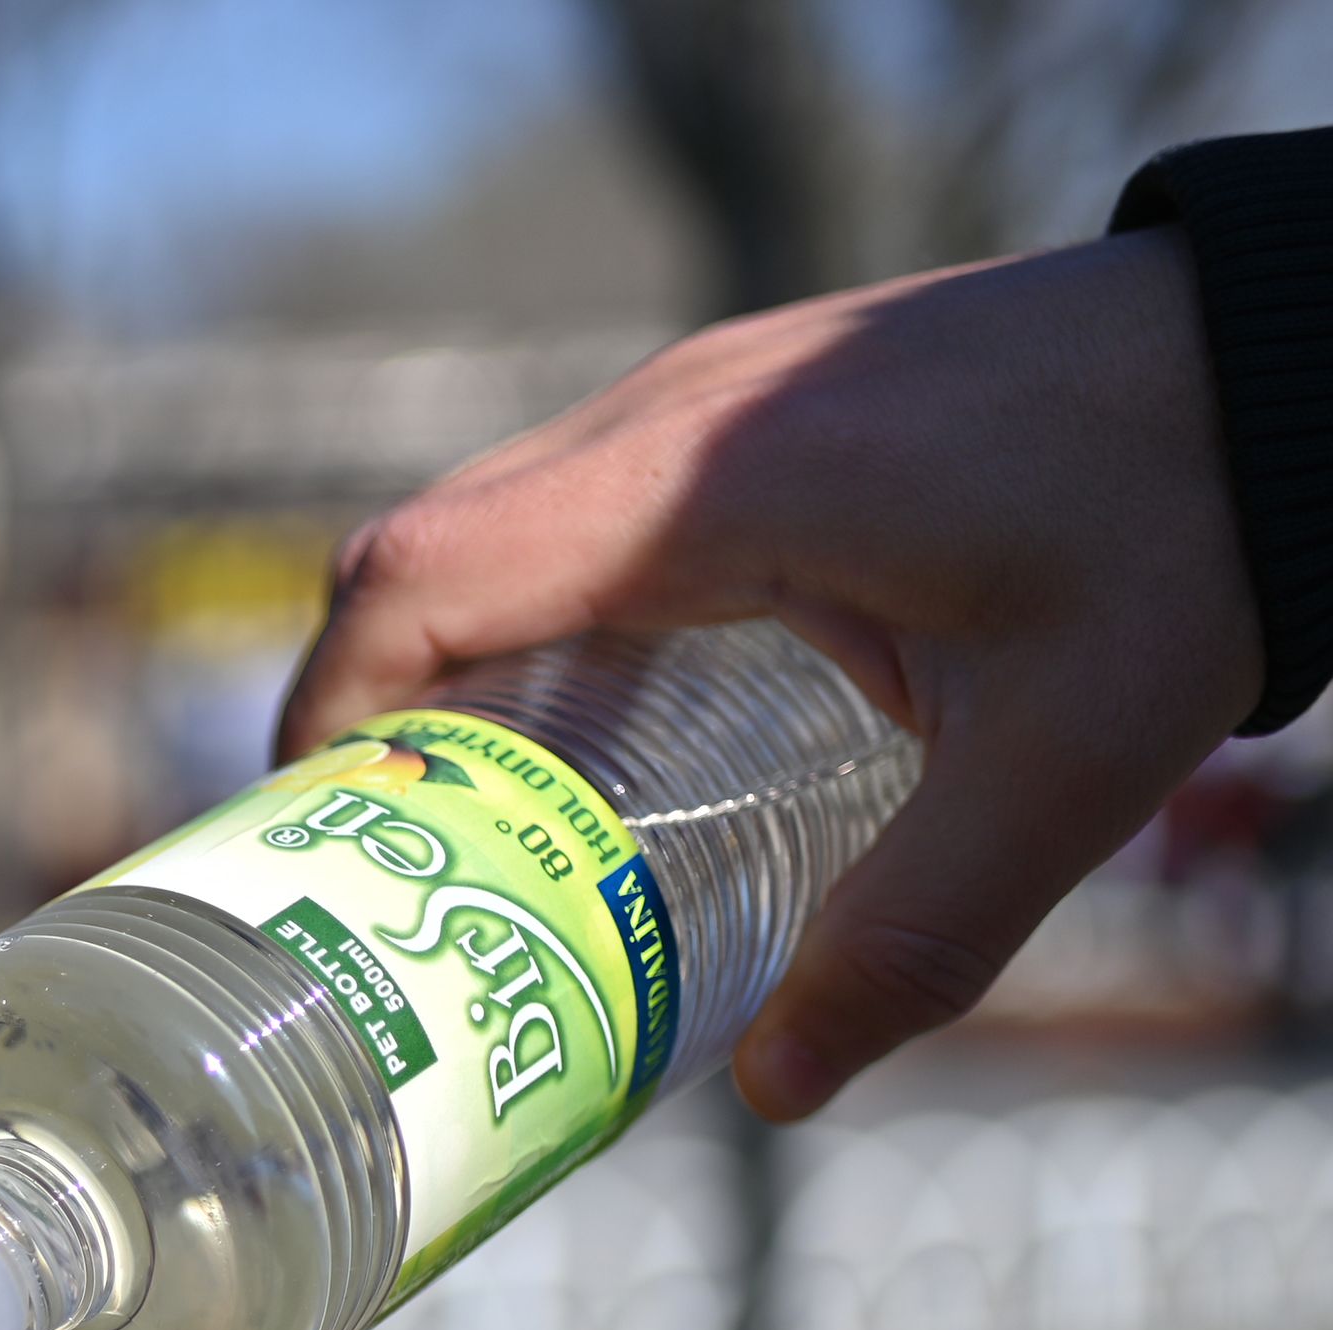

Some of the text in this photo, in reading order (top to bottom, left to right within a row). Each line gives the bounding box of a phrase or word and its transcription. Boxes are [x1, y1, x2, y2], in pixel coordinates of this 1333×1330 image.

[275, 919, 407, 1077] PET BOTTLE
[337, 937, 405, 1014] 500ml
